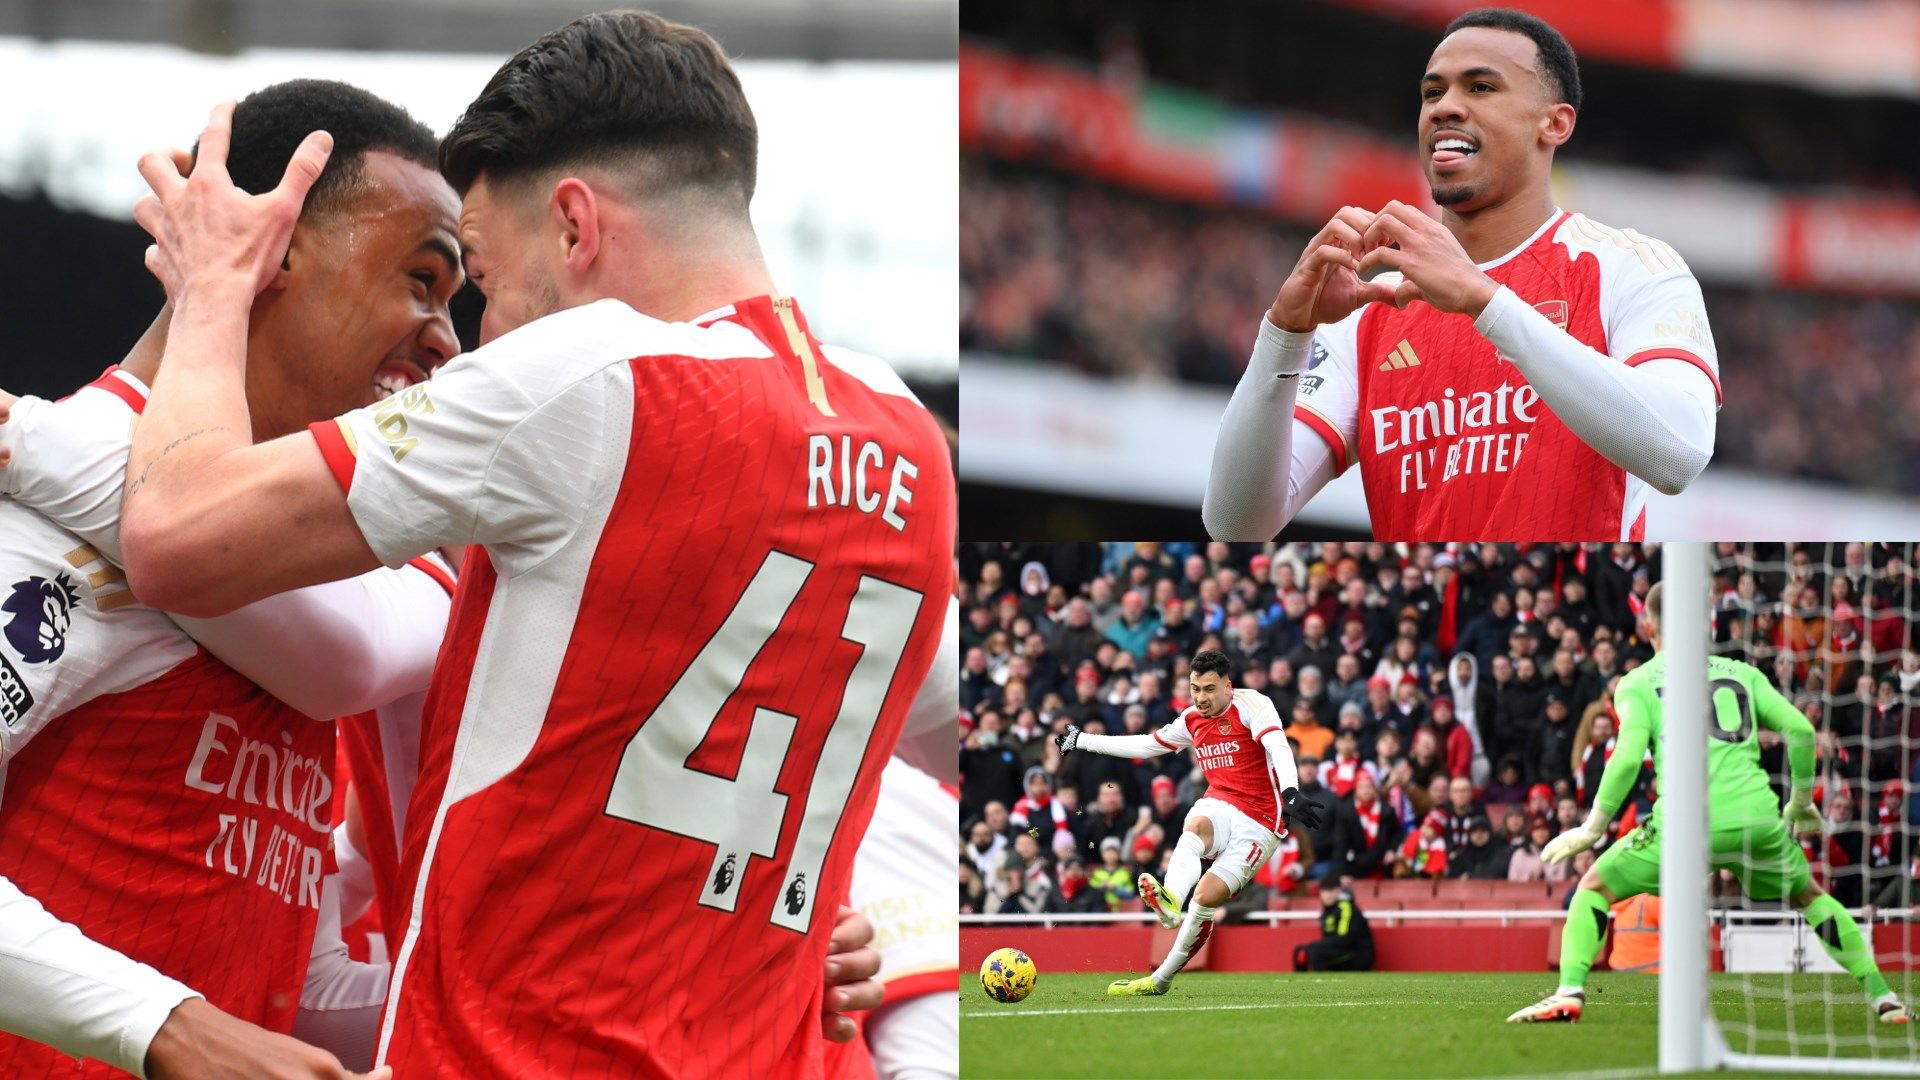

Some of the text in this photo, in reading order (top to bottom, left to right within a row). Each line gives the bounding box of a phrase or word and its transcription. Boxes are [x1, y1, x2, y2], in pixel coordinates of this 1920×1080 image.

[807, 434, 919, 533] RICE
[603, 547, 926, 935] 41
[205, 813, 258, 879] FLY
[1245, 842, 1263, 869] 11
